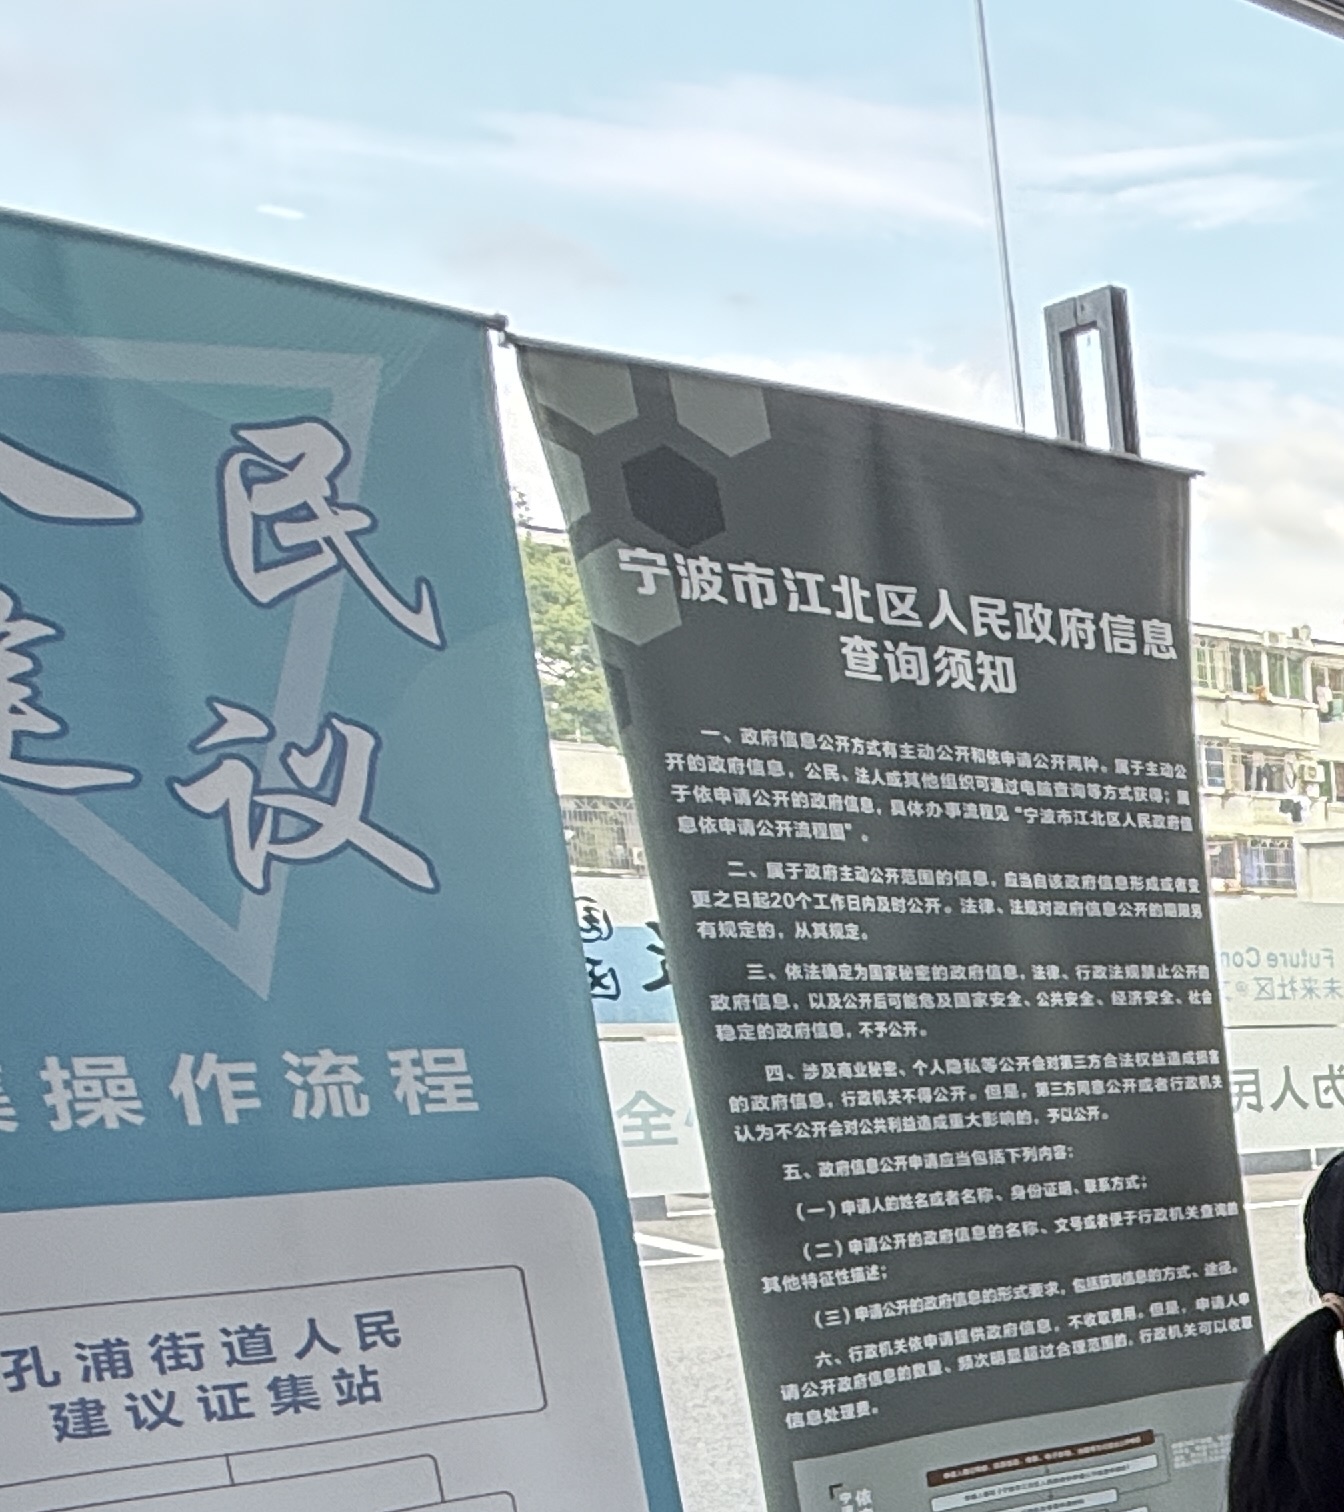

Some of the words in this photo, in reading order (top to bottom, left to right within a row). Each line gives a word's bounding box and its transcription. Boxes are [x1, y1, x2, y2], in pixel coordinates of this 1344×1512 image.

[618, 547, 1178, 661] 宁波市江北区人民政府信息
[841, 635, 1018, 696] 查询须知
[0, 1047, 479, 1136] 操作流程
[1, 1310, 402, 1393] 孔浦街道人民
[49, 1364, 382, 1443] 建议证集站
